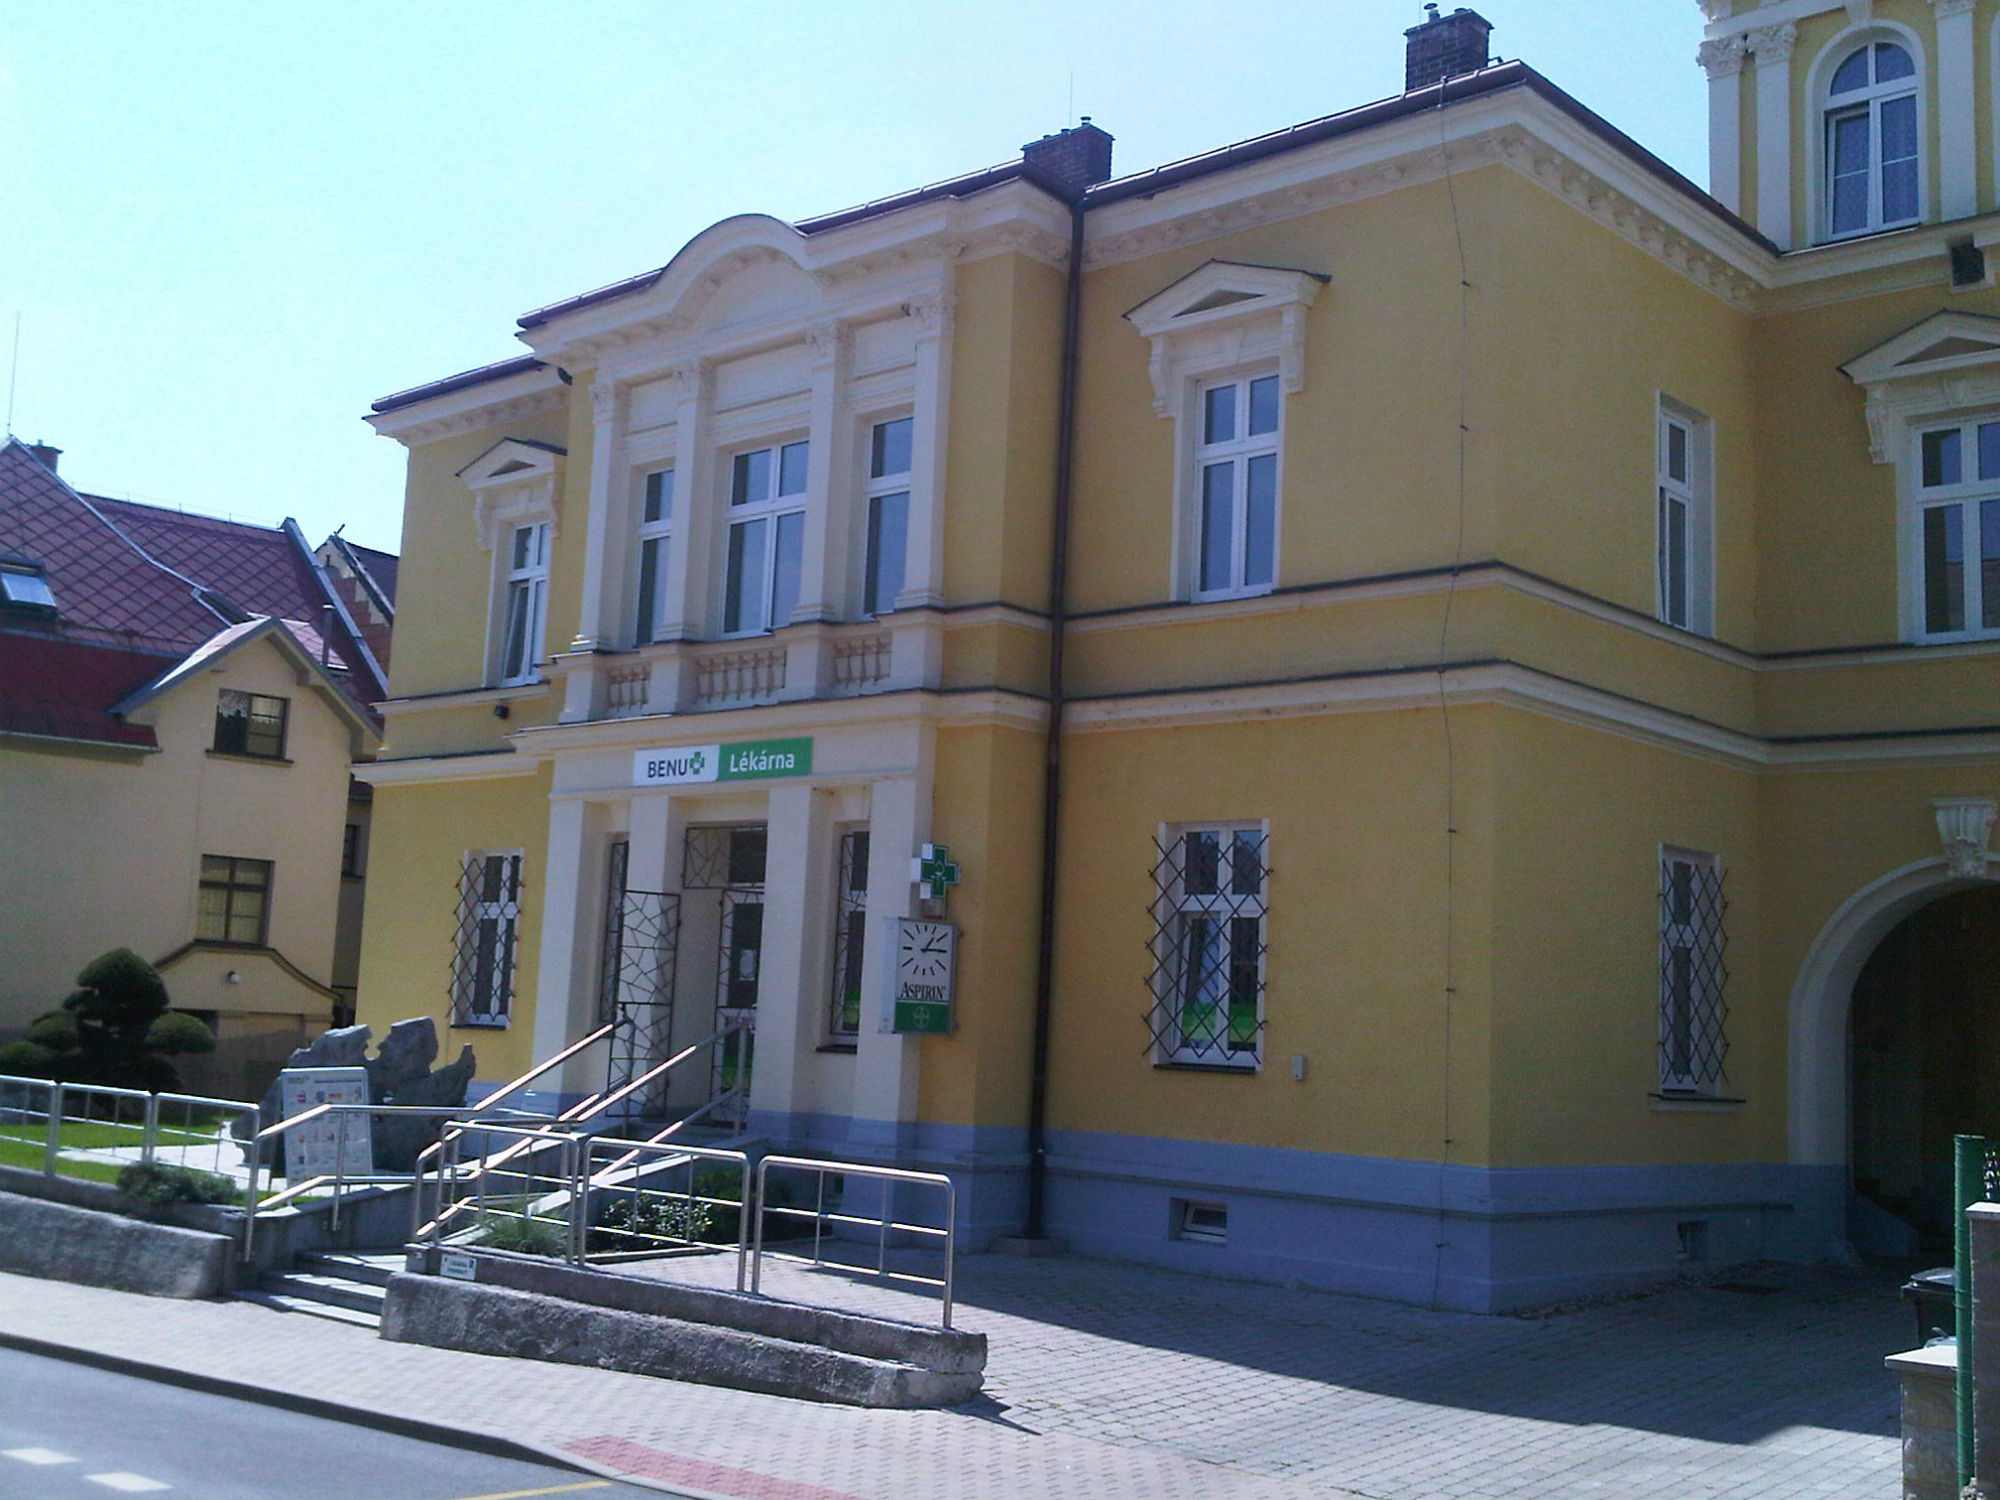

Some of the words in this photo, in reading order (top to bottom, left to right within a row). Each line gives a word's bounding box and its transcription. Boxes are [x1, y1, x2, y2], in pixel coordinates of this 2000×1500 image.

[648, 758, 688, 778] BENU
[729, 750, 795, 773] Lékárna
[900, 981, 944, 1000] ASPIRIN
